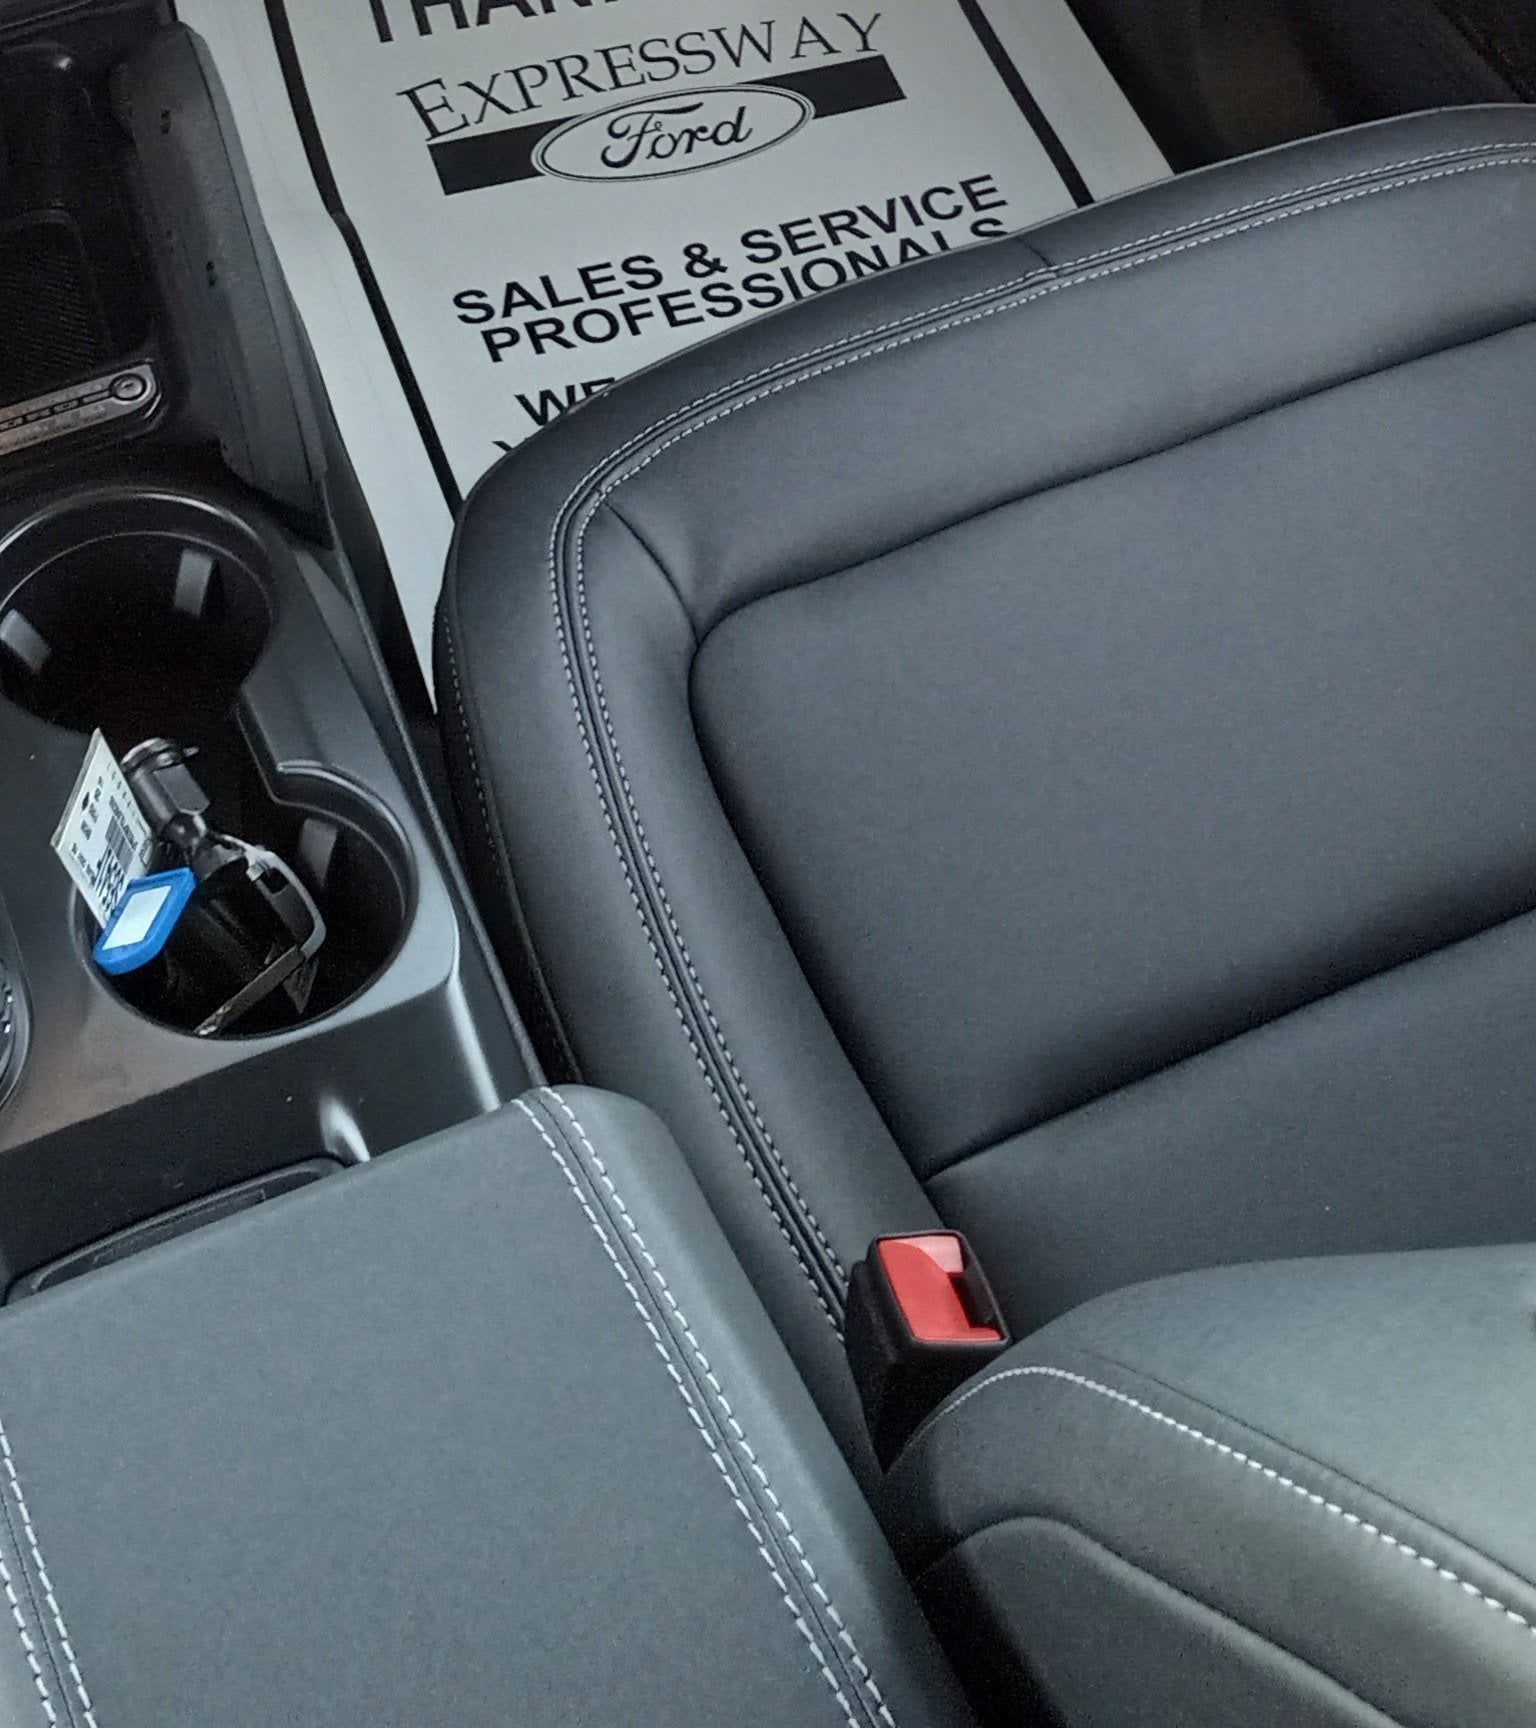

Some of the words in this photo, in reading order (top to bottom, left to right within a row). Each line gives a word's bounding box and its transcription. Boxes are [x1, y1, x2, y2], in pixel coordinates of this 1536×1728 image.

[397, 12, 884, 141] EXPRESSWAY
[599, 102, 754, 169] Ford
[452, 254, 664, 325] SALES
[681, 242, 729, 280] &
[740, 174, 1009, 264] SERVICE
